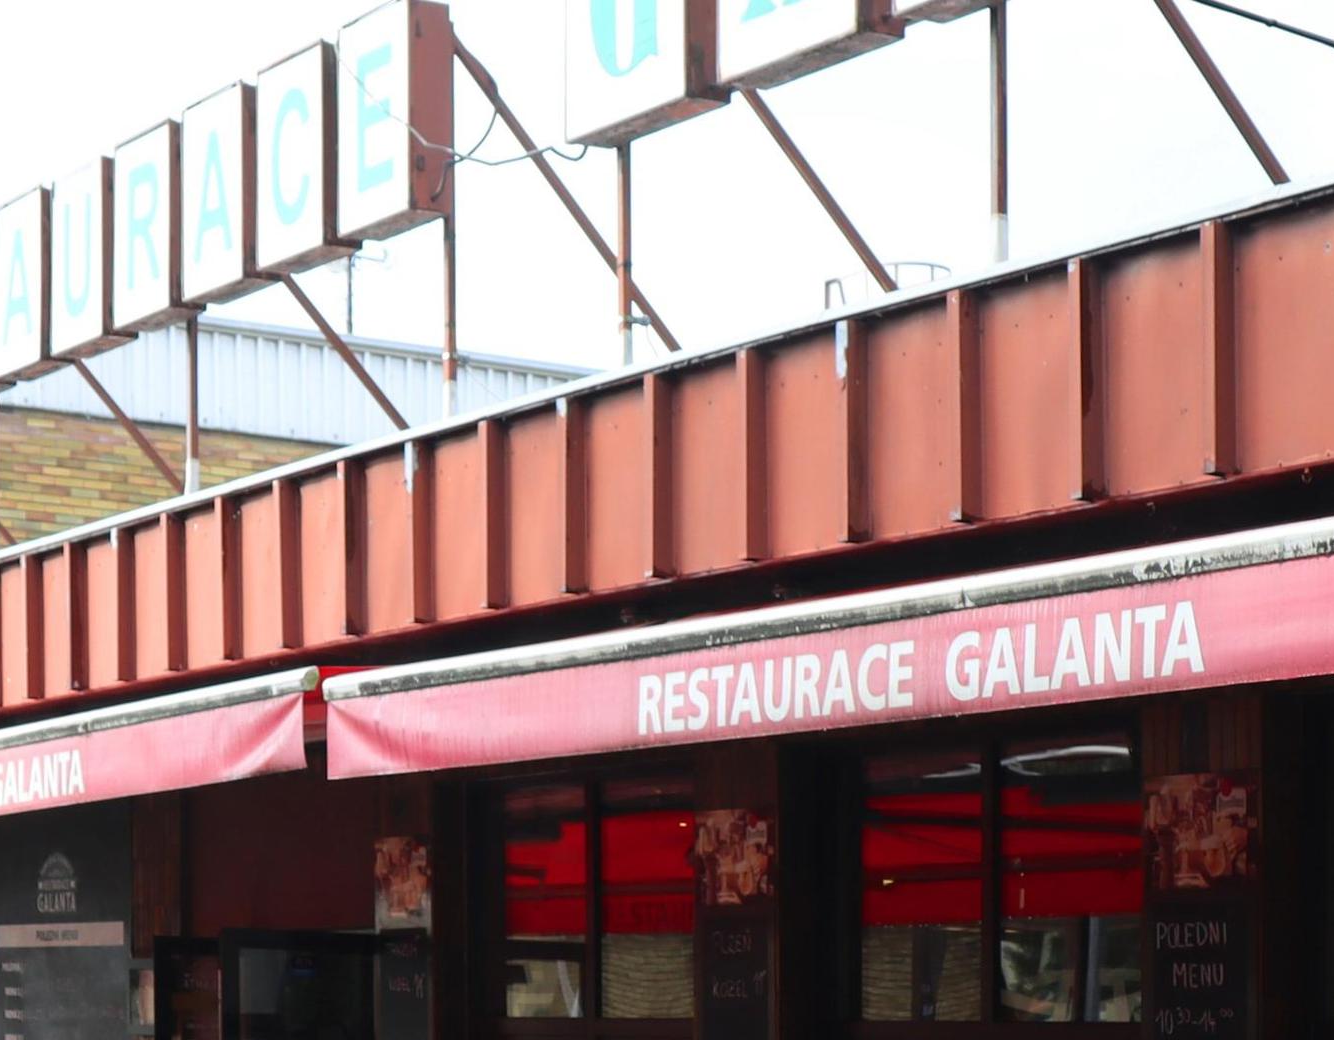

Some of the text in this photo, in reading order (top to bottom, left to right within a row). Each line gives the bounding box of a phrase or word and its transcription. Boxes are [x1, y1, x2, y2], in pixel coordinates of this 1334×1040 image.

[638, 600, 1205, 736] RESTAURACE GALANTA
[37, 891, 76, 913] GALANTA
[1172, 962, 1224, 989] MENU
